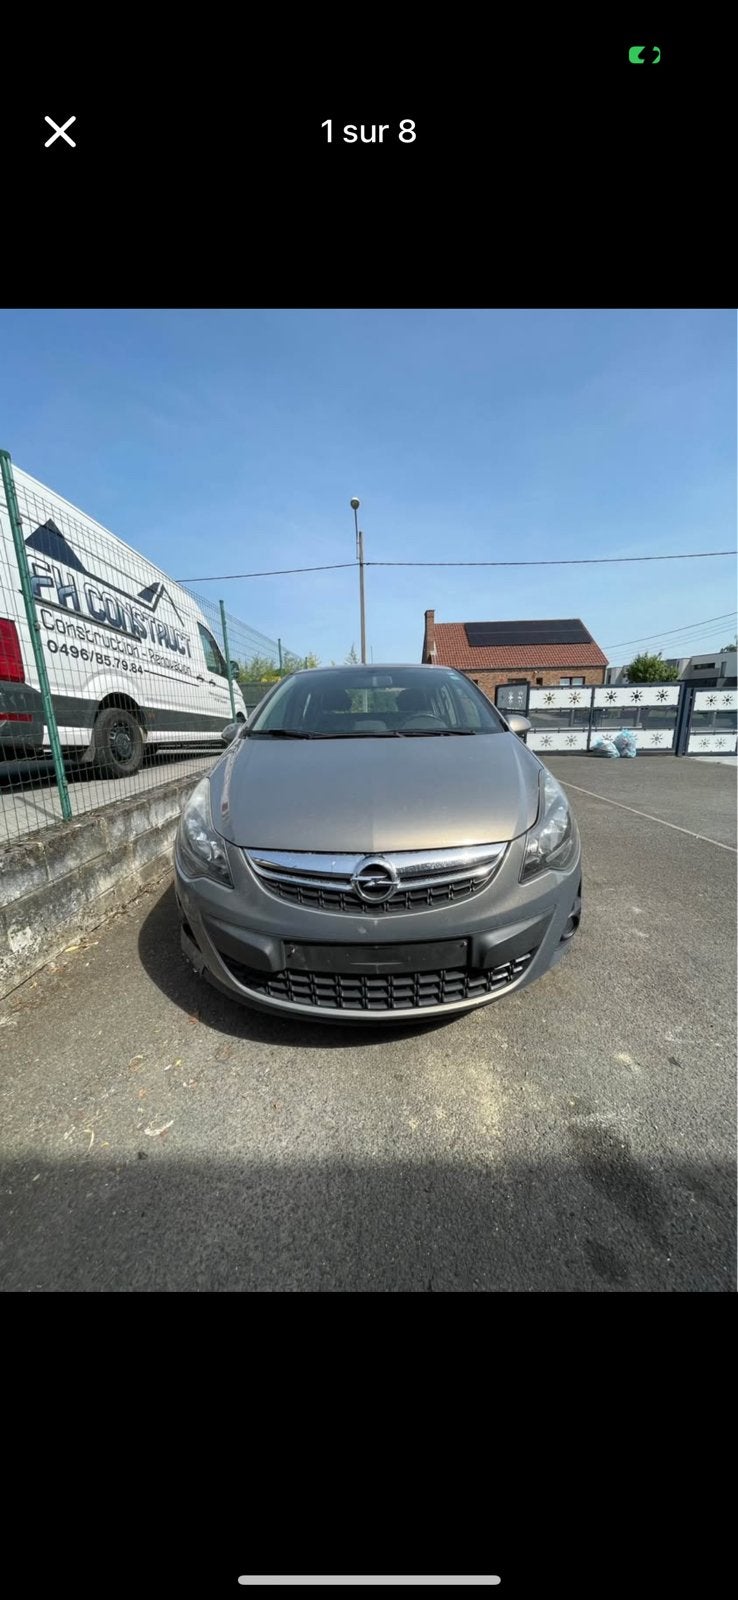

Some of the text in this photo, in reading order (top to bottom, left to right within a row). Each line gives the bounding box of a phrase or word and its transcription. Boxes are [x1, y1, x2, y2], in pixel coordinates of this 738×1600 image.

[27, 554, 191, 658] FH CONSTRUCT
[40, 609, 140, 658] Construction
[47, 639, 143, 674] 0496/85.79.84
